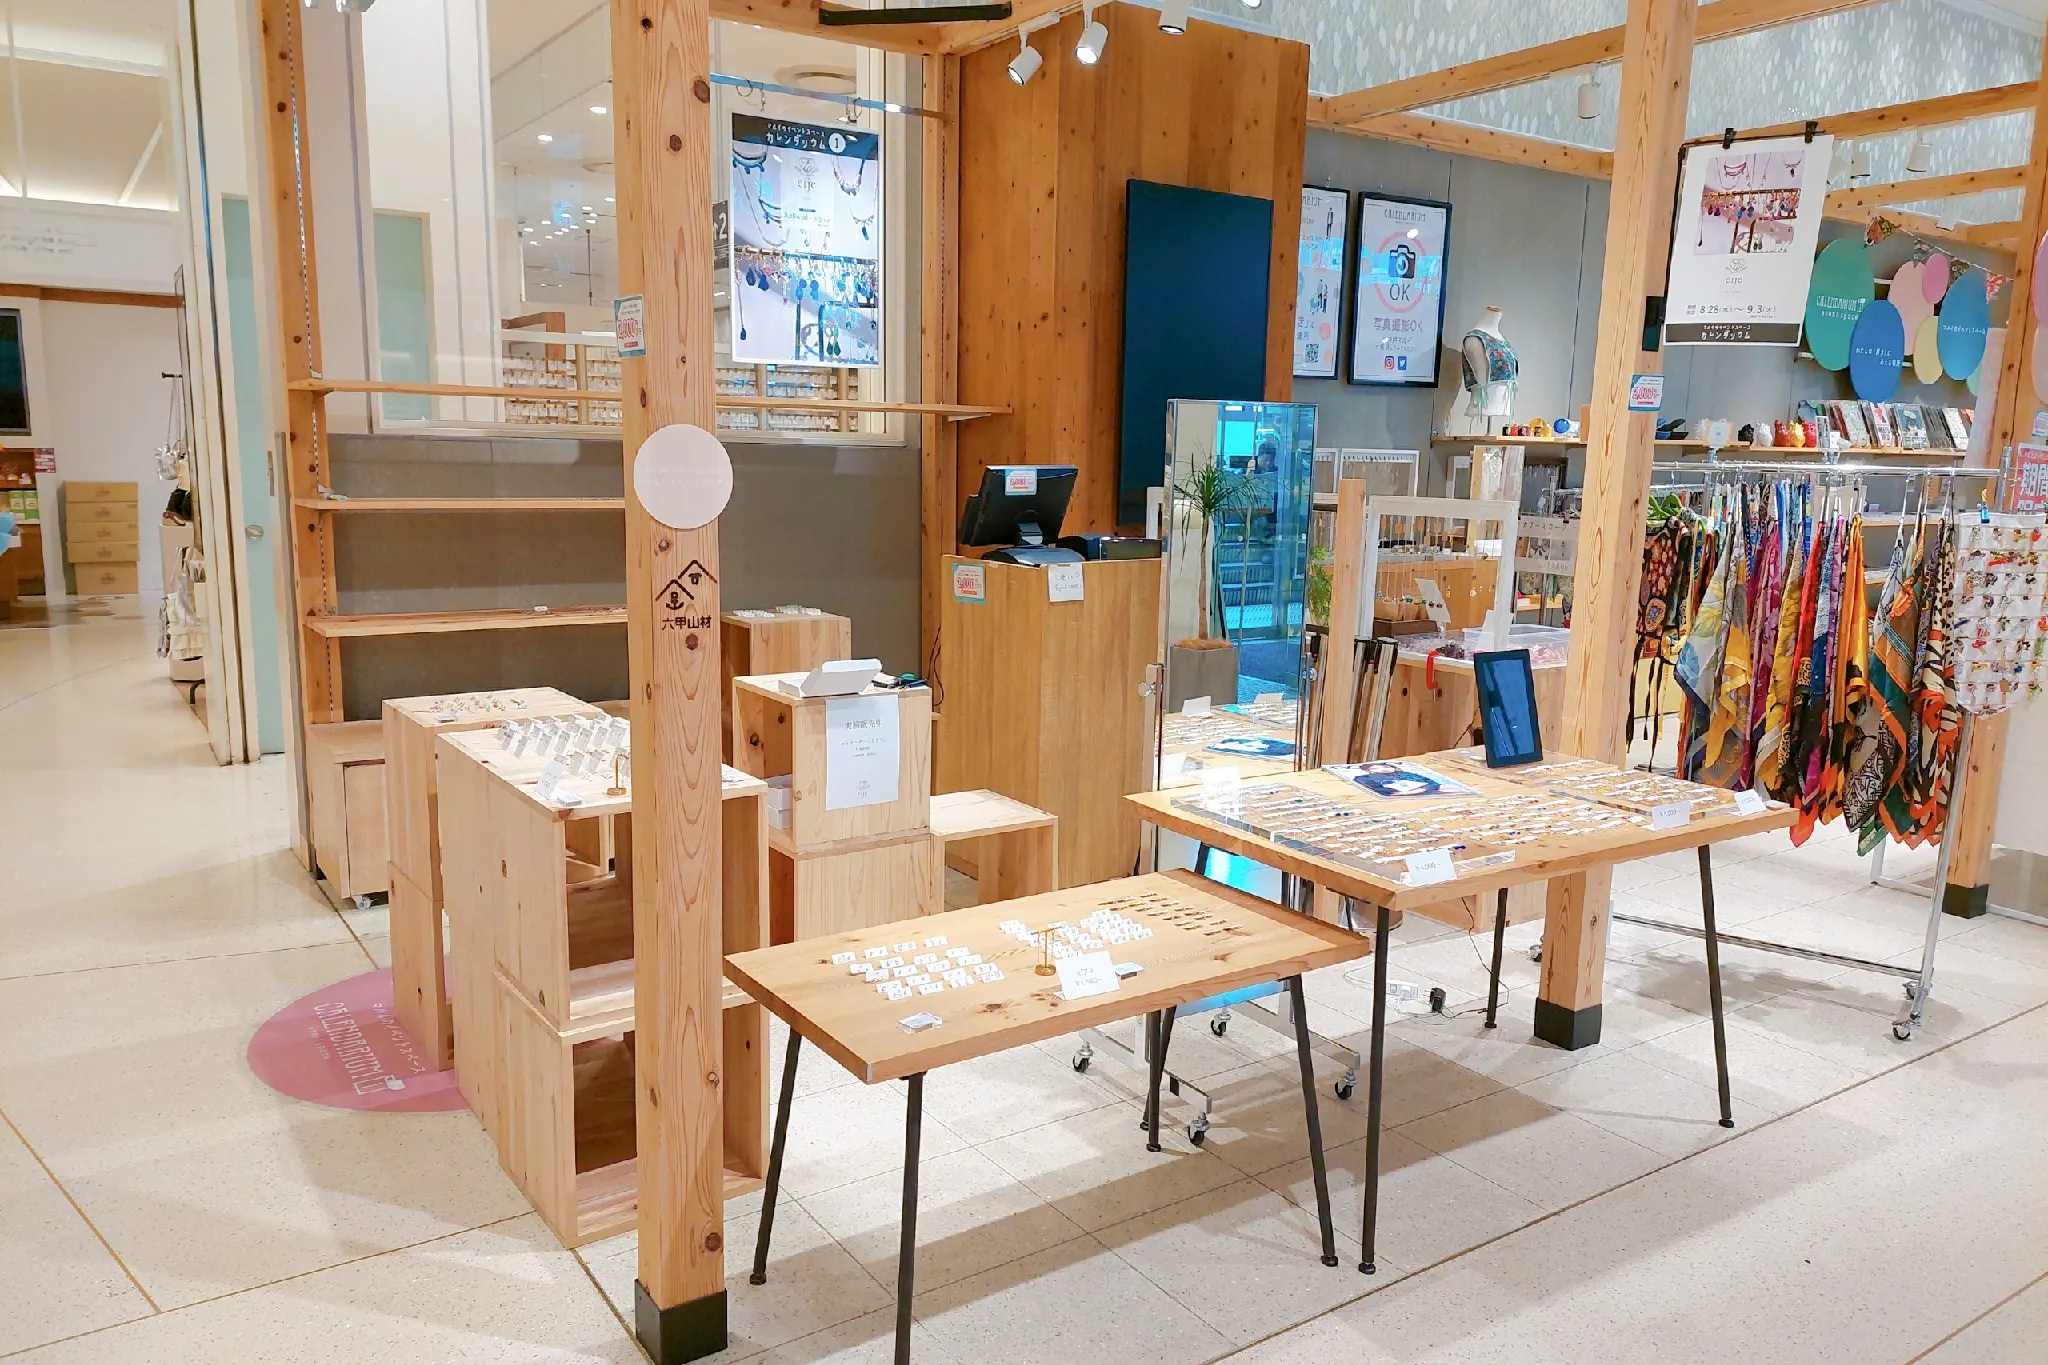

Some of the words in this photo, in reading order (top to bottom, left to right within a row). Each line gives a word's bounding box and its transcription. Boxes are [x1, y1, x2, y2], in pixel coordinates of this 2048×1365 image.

[1389, 283, 1411, 301] OK
[661, 615, 712, 631] 六甲山材
[312, 1001, 386, 1080] CALENDARIUM
